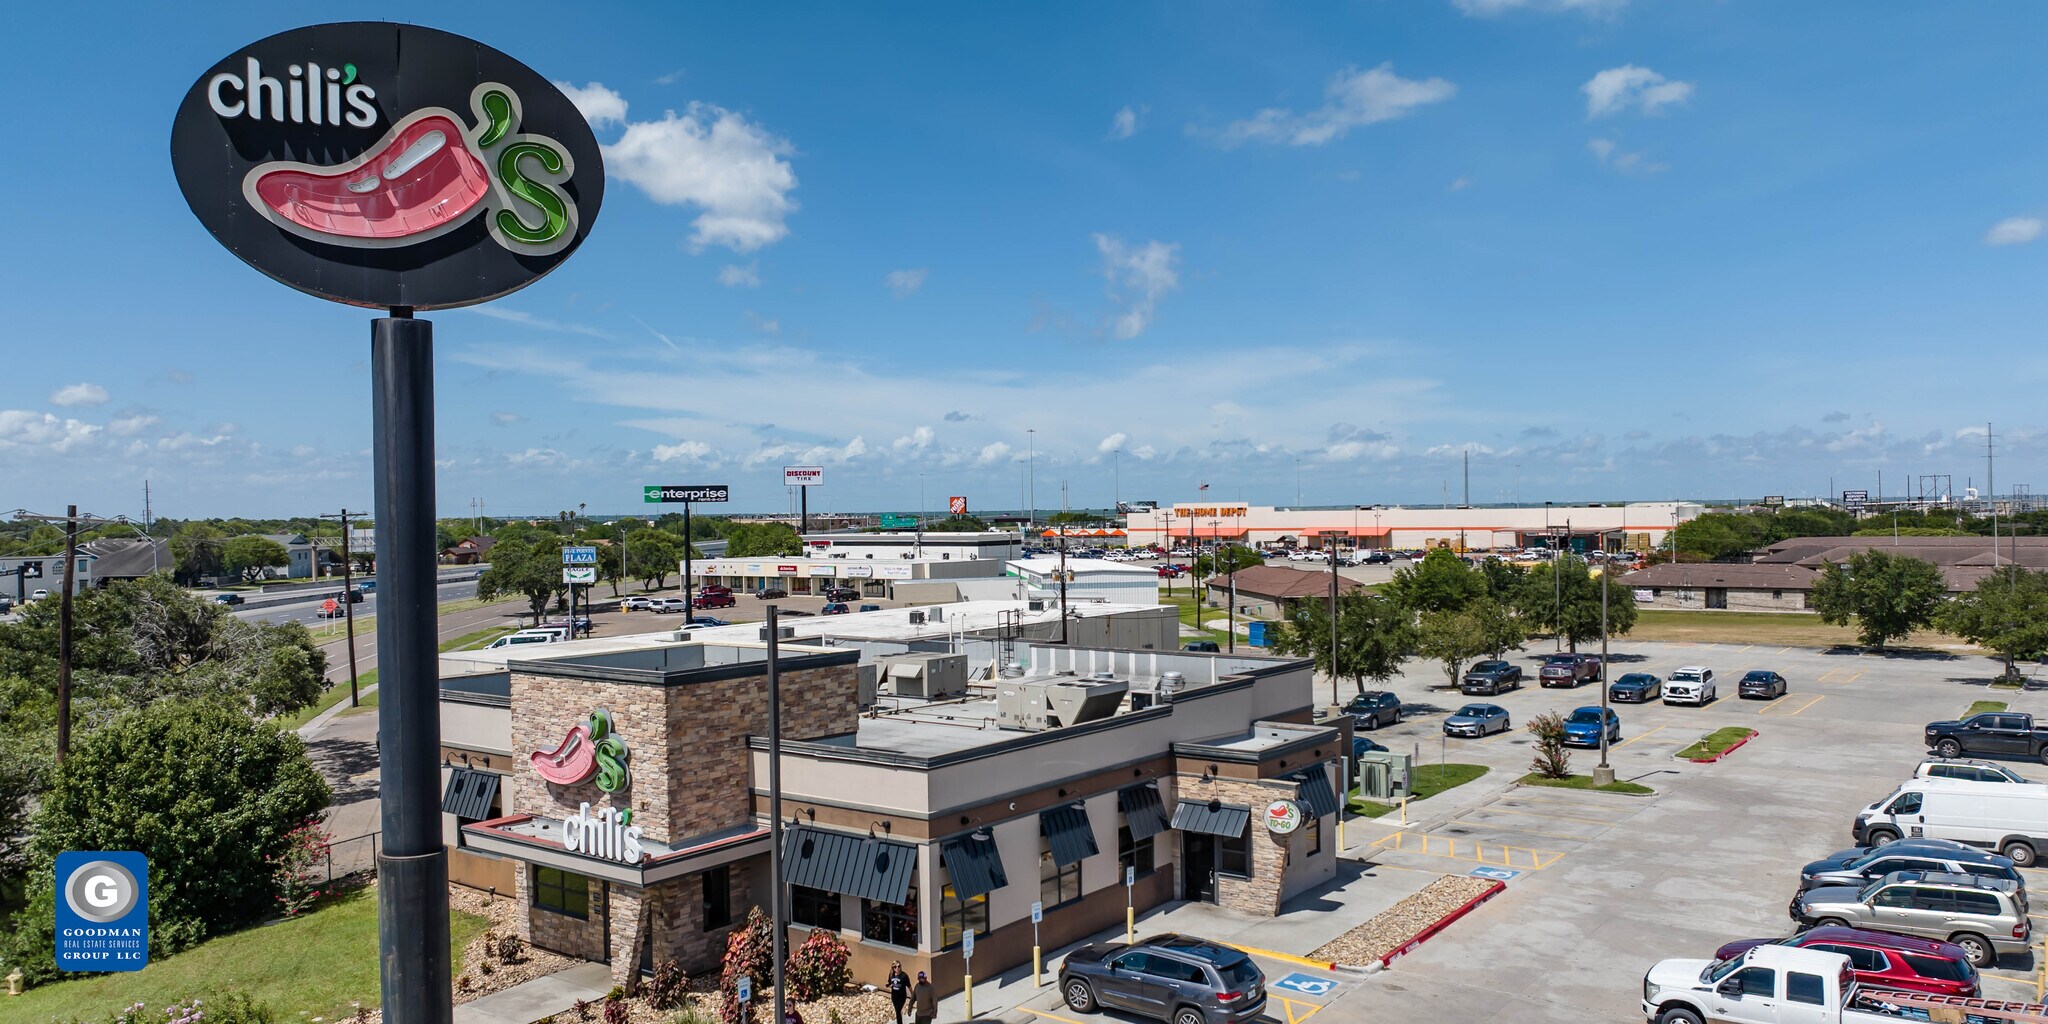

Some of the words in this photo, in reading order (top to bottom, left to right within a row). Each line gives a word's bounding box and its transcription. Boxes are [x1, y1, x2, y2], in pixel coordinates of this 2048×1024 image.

[208, 56, 377, 128] chili's
[645, 488, 727, 500] enterprise
[950, 497, 965, 513] HOME
[1174, 508, 1191, 517] THE
[1194, 507, 1217, 517] HOME
[1220, 507, 1247, 517] DEPOT
[563, 801, 644, 865] chili's
